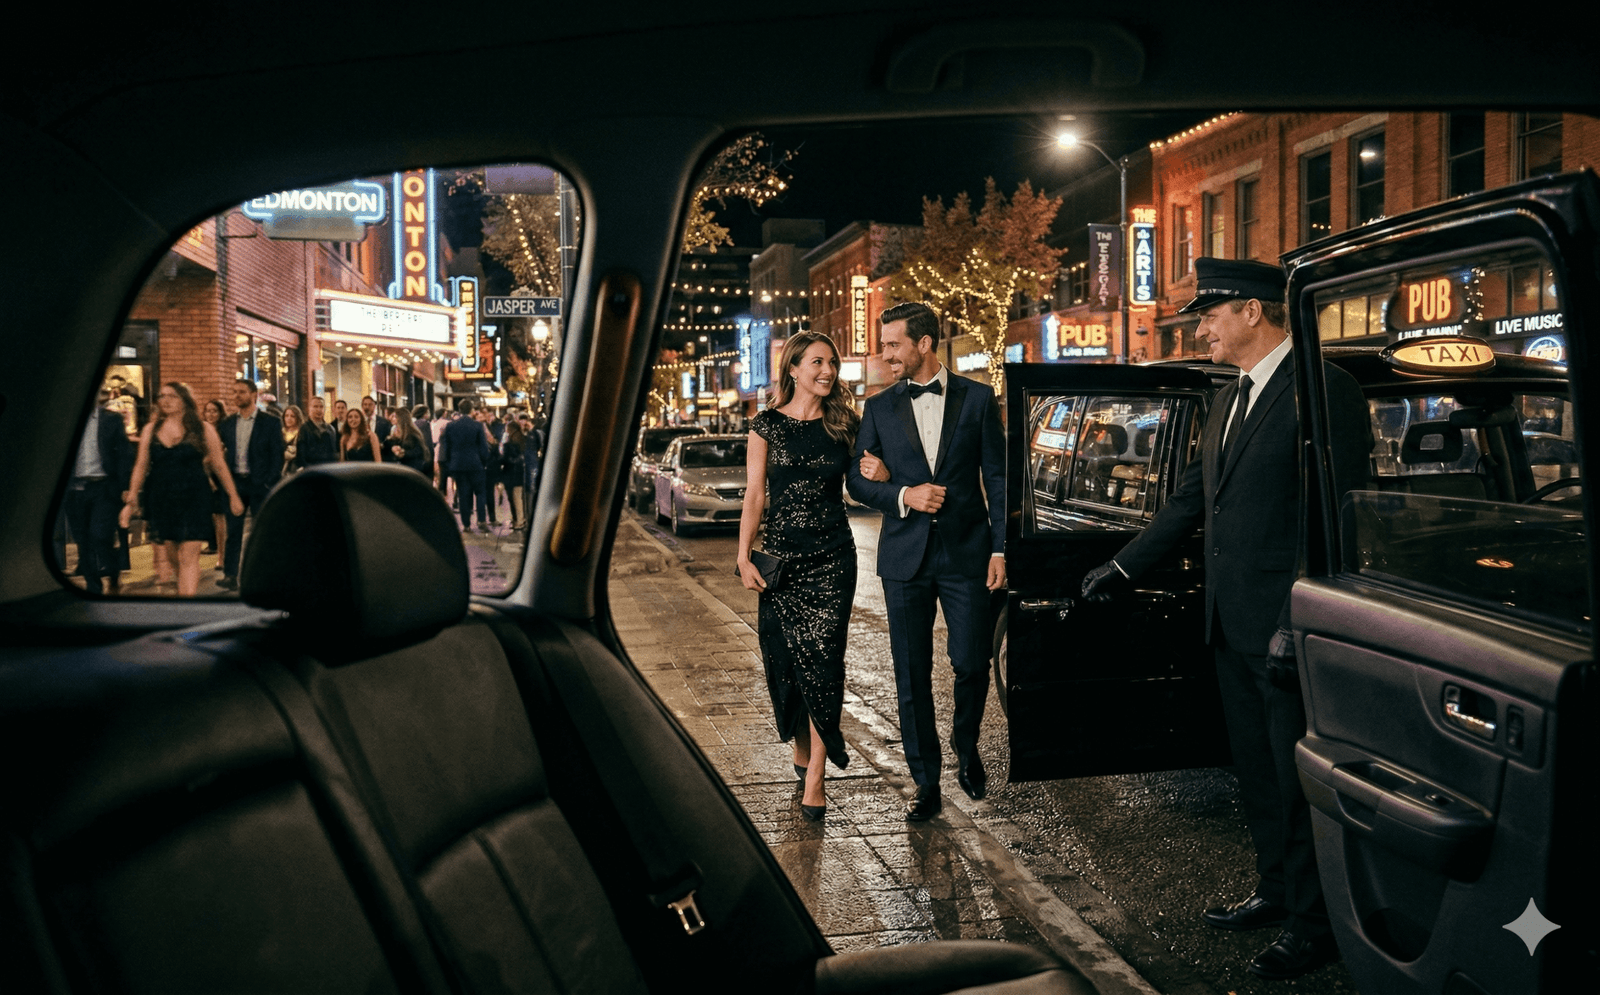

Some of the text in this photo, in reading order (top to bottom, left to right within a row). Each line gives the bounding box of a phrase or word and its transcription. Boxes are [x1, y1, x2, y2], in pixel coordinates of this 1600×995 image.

[251, 190, 377, 212] EDMONTON
[1133, 208, 1156, 223] THE
[403, 169, 427, 297] ONTON
[1136, 239, 1151, 301] ARTS
[488, 299, 557, 314] JASPER AVE
[1408, 278, 1451, 323] PUB
[1495, 313, 1564, 335] LIVE MUSIC
[1060, 324, 1108, 347] PUB
[1420, 346, 1481, 363] TAXI
